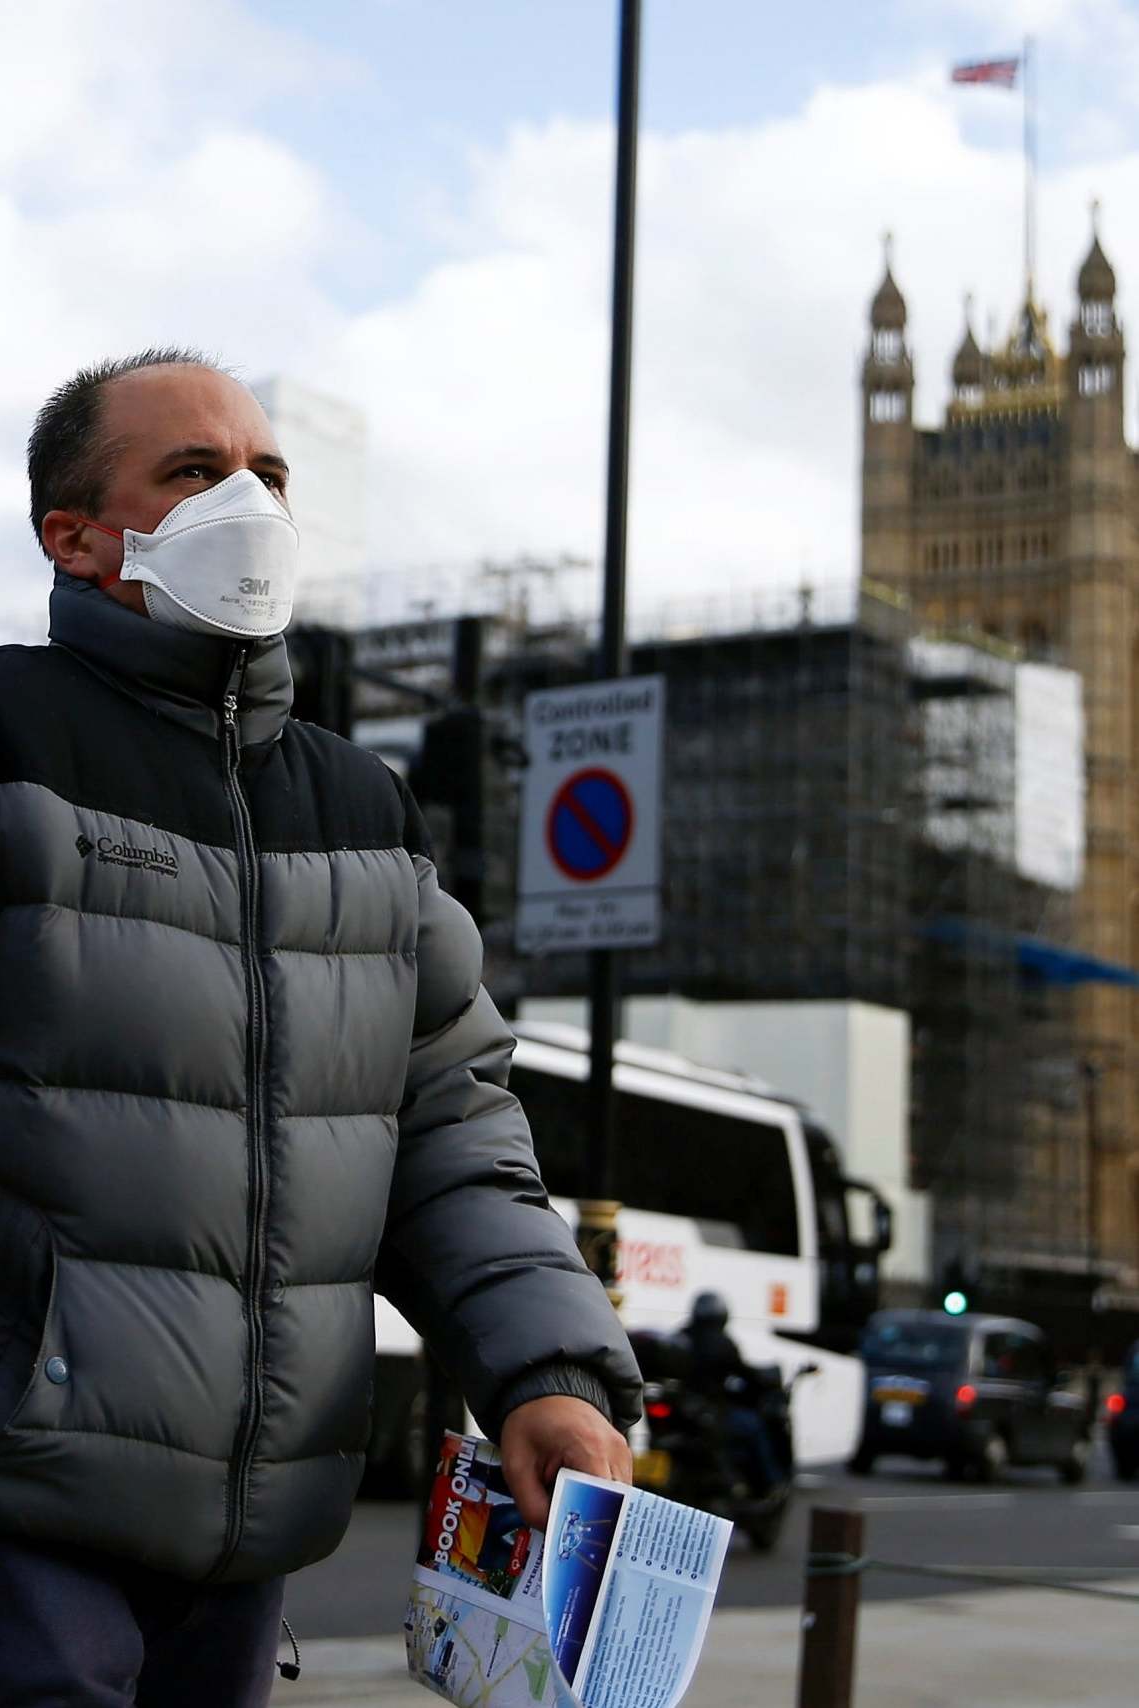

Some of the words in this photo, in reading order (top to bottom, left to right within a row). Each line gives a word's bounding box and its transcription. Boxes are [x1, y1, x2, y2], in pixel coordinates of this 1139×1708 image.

[238, 577, 270, 596] 3M
[535, 688, 651, 723] Controlled
[549, 722, 632, 761] ZONE
[97, 837, 178, 869] Columbia
[142, 861, 179, 879] Company
[434, 1497, 463, 1566] BOOK
